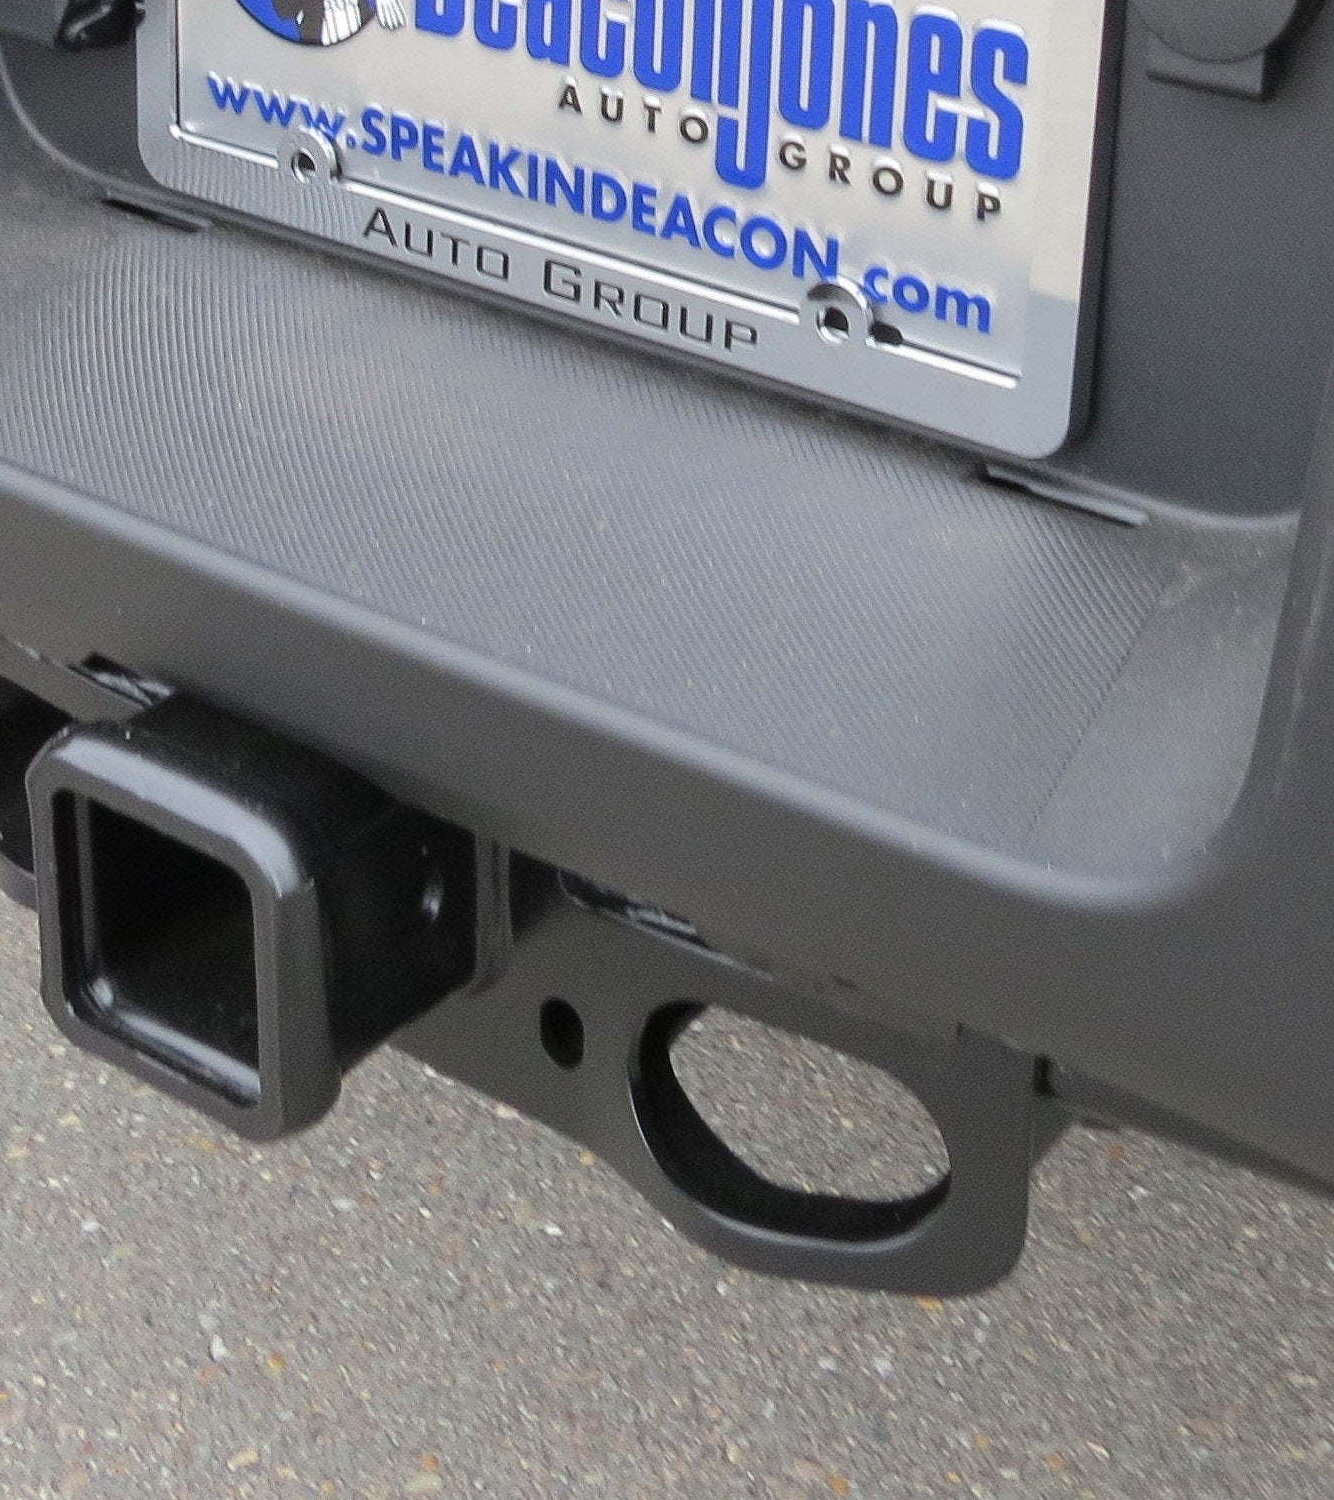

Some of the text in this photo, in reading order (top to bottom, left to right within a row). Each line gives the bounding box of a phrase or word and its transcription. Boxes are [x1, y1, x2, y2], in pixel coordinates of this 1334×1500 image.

[206, 71, 992, 334] www.SPEAKINDEACONcom
[557, 77, 1003, 223] AUTO GROUP
[362, 206, 759, 353] AUTO GROUP
